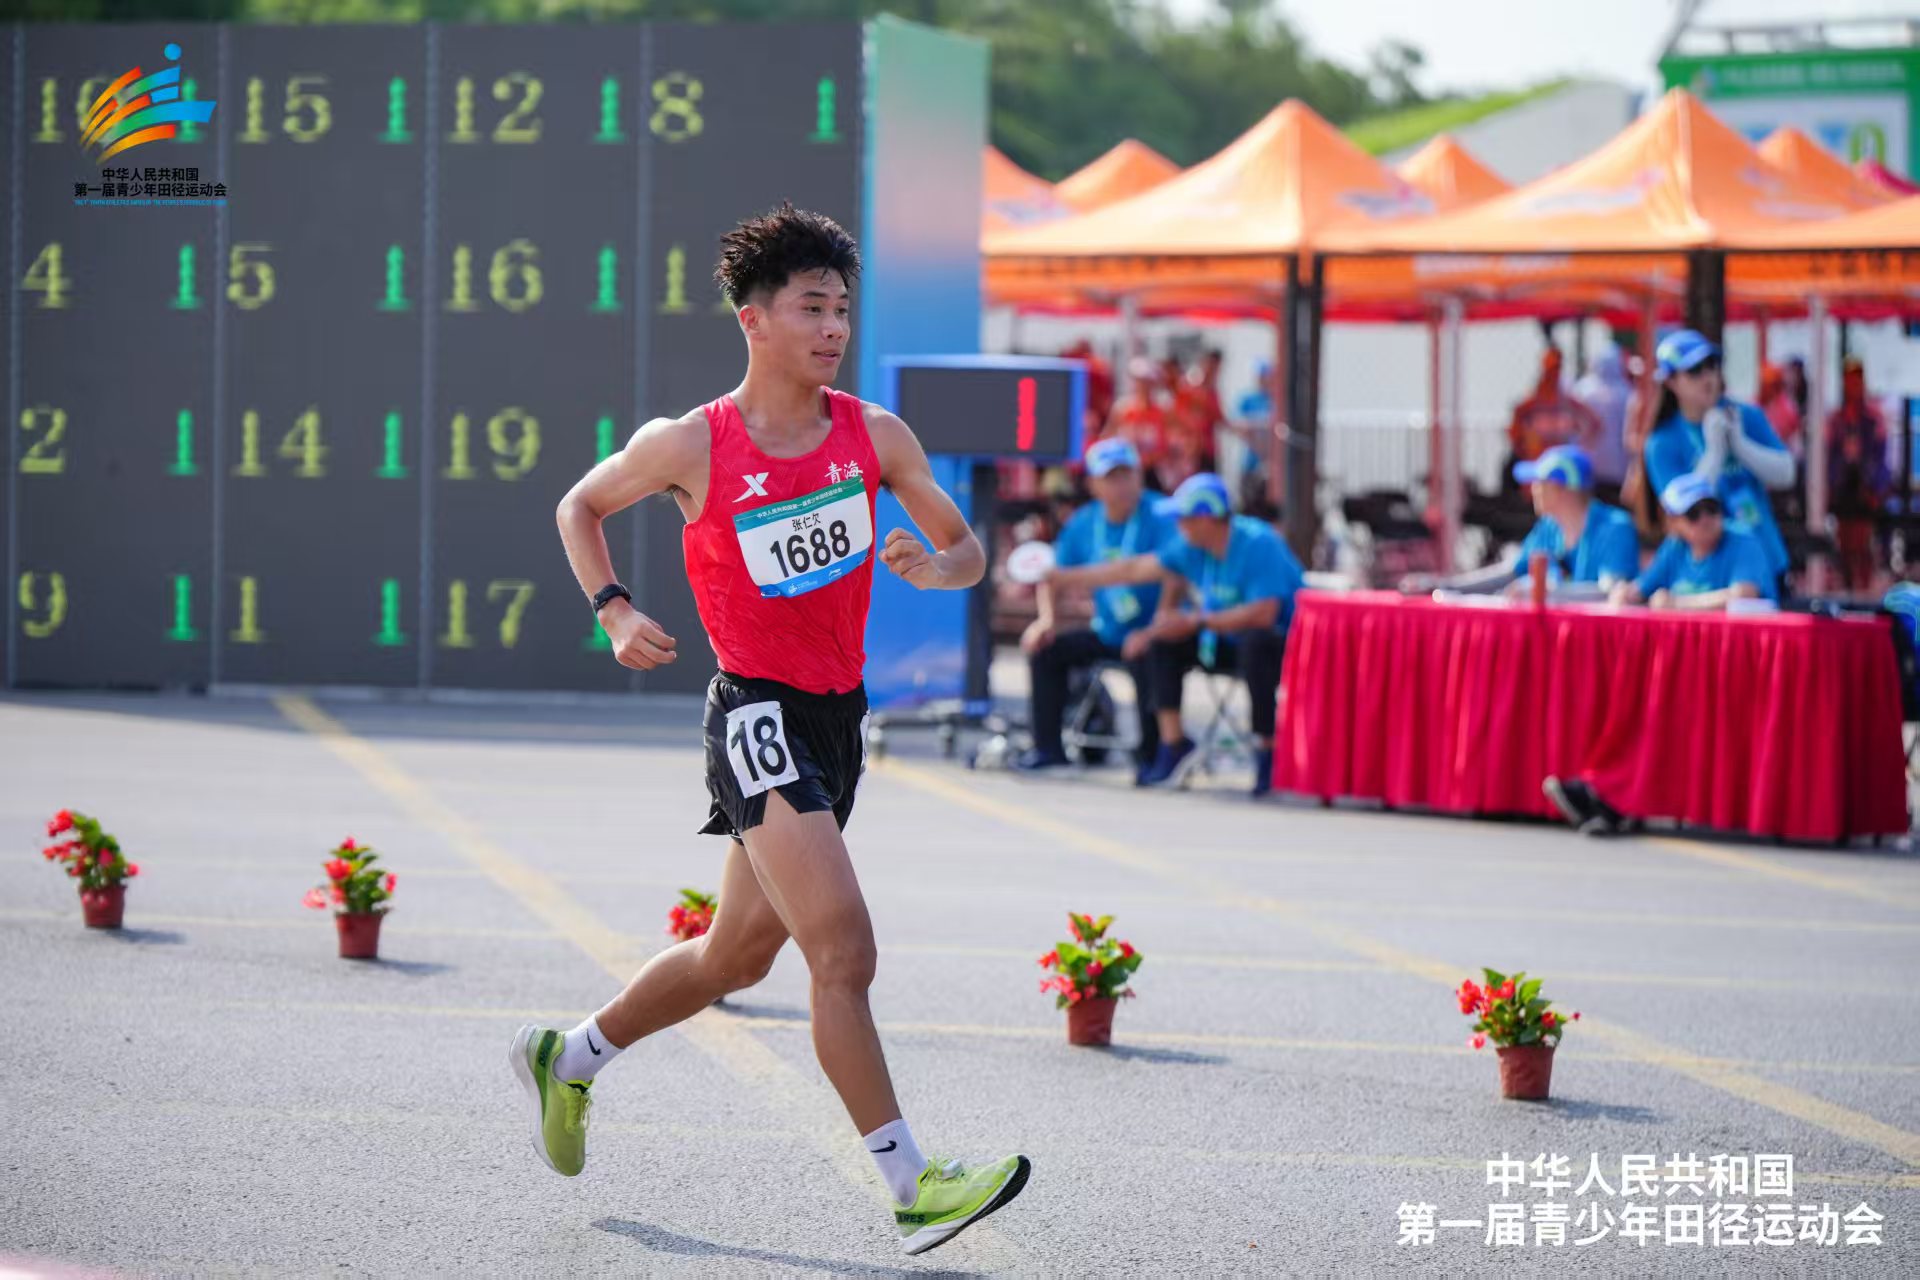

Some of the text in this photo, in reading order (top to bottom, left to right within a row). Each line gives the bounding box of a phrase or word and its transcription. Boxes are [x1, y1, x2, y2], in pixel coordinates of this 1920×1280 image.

[237, 76, 414, 143] 15 1
[449, 72, 626, 143] 12 1
[649, 72, 843, 143] 8 1
[21, 243, 202, 310] 4 1
[226, 244, 413, 312] 5 1
[443, 239, 624, 312] 16 1
[19, 405, 199, 476] 2 1
[231, 407, 409, 479] 14 1
[440, 407, 541, 481] 19
[1016, 376, 1037, 451] 1
[825, 460, 864, 484] 青海
[770, 519, 850, 578] 1688
[19, 570, 200, 642] 9 1
[230, 576, 408, 646] 1 1
[437, 578, 535, 648] 17
[731, 715, 787, 782] 18
